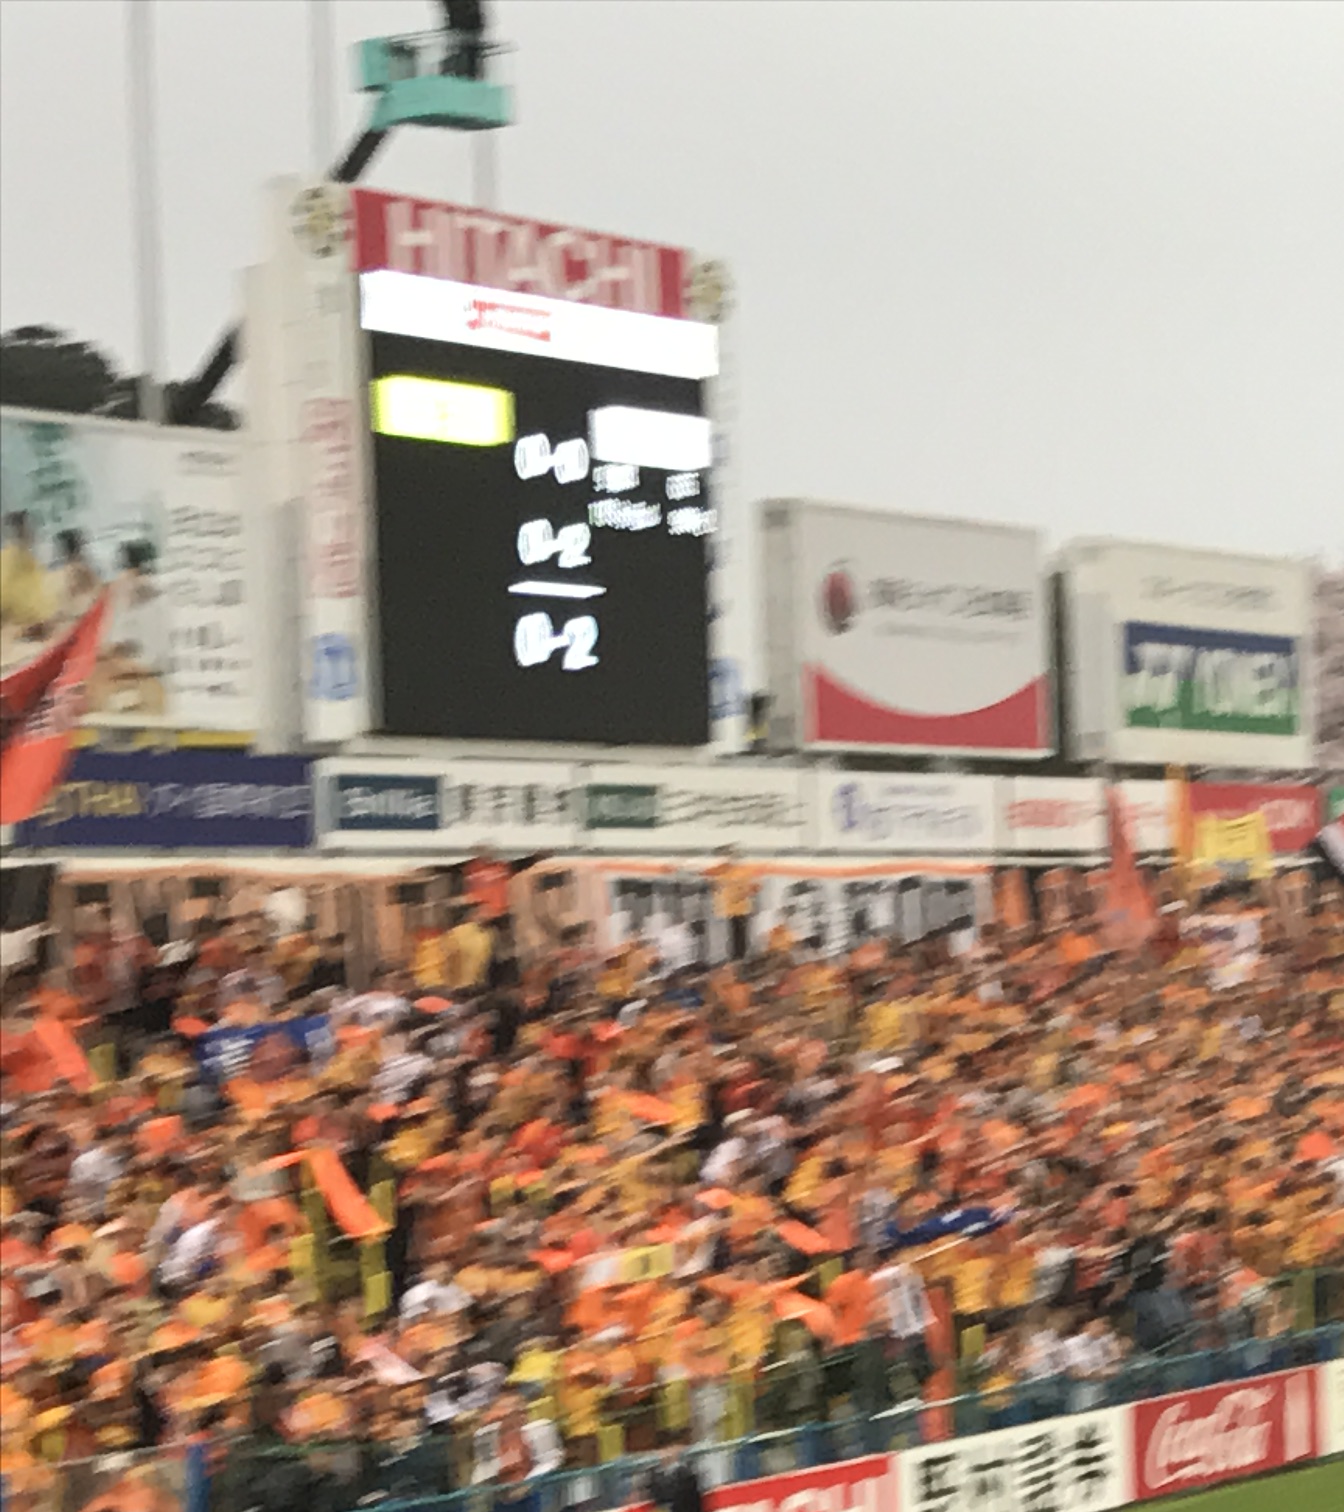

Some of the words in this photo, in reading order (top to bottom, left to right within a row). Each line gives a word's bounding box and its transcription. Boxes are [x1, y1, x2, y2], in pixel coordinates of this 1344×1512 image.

[384, 200, 663, 315] HITACHI
[517, 518, 592, 568] 0-2
[514, 611, 599, 670] 0-2
